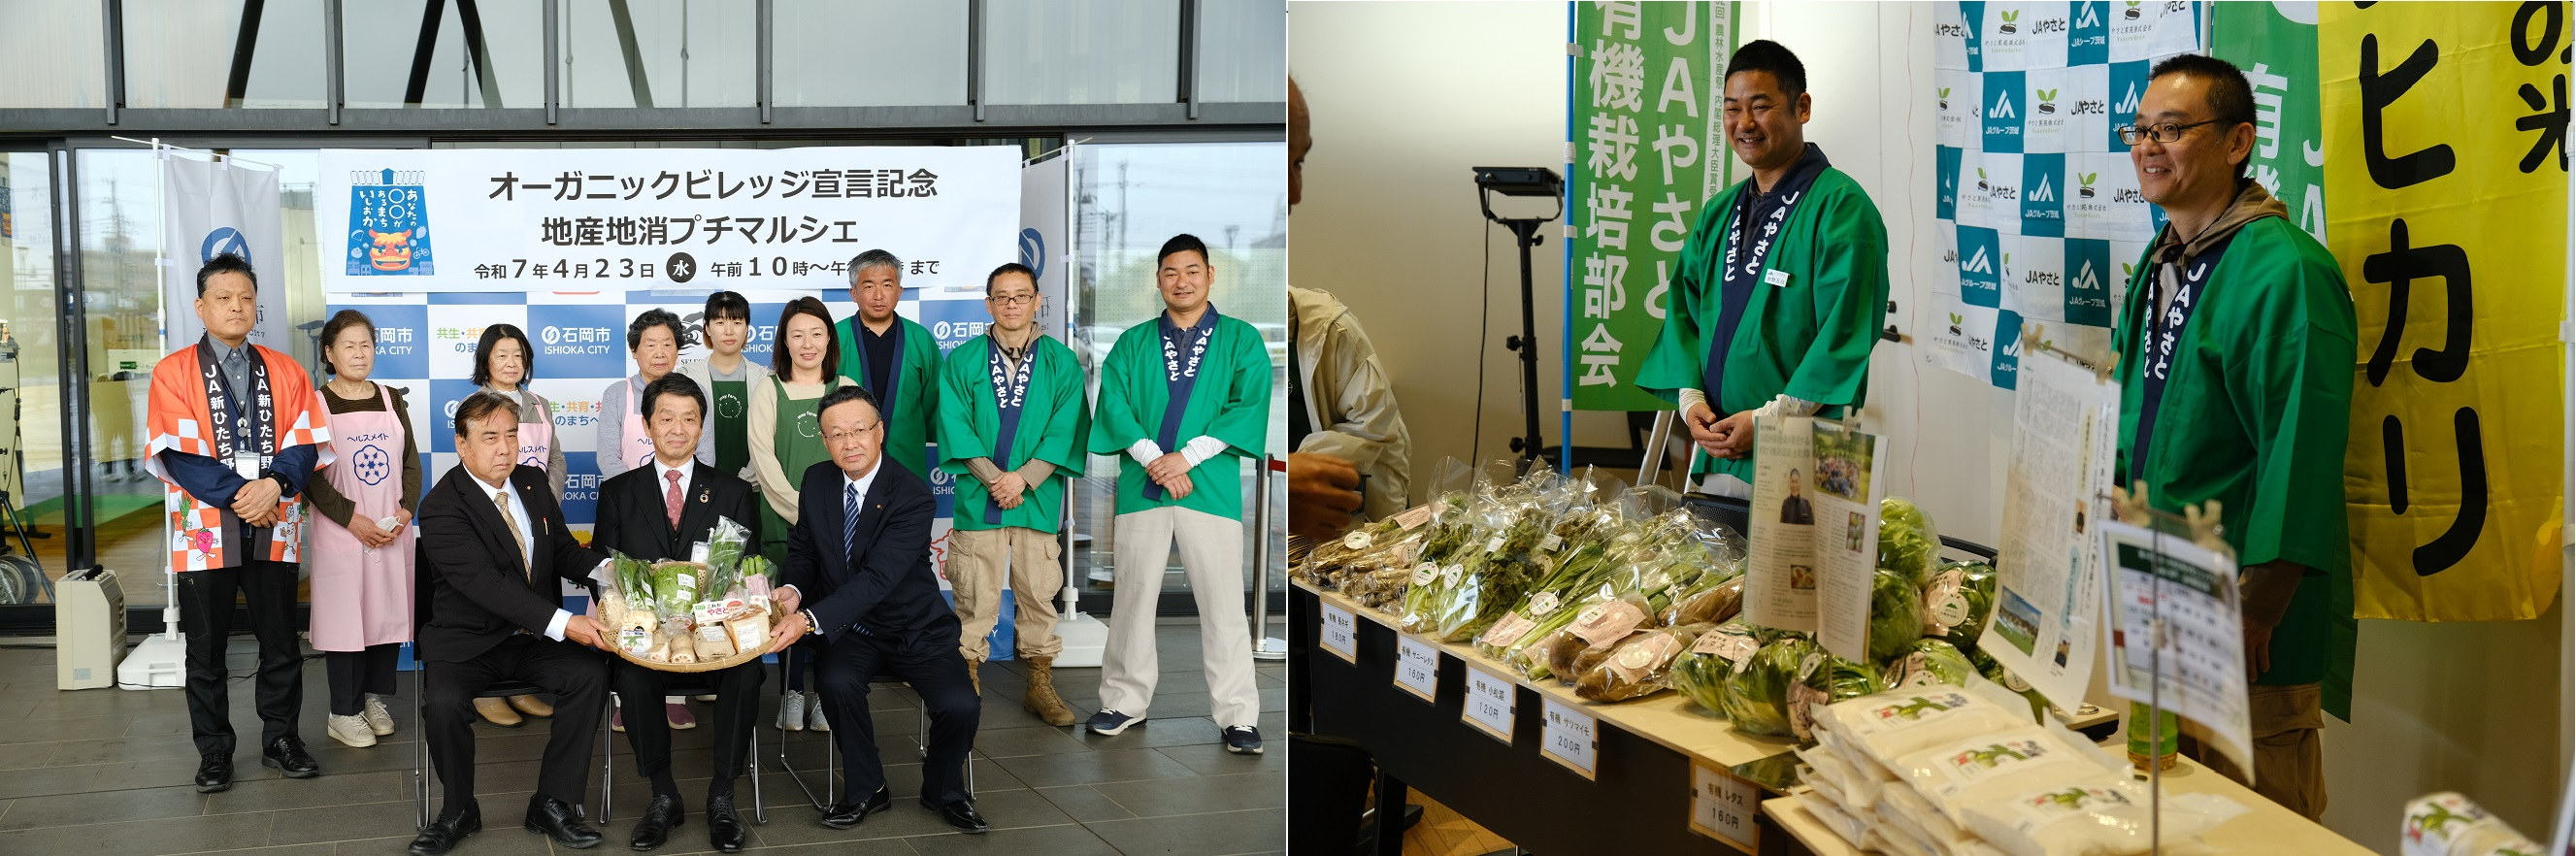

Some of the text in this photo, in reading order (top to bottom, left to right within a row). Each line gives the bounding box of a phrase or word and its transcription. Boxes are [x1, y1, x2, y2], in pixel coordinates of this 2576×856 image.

[2031, 17, 2065, 35] JAやさと
[1715, 24, 1725, 89] 農林水産祭
[2070, 100, 2104, 115] JAやさと
[489, 169, 939, 201] オーガニックビレッジ宣言記念
[359, 190, 379, 227] いしおか
[378, 190, 388, 228] あるまち
[407, 189, 418, 226] あなたの
[541, 214, 859, 247] 地産地消プチマルシェ
[1745, 191, 1800, 276] JAやさと
[710, 255, 852, 278] 午前10時～午
[910, 259, 940, 276] まで
[2025, 270, 2060, 286] JAやさと
[2357, 0, 2489, 577] ヒカリ
[952, 321, 995, 338] 石岡
[2154, 262, 2207, 380] JAやさと
[562, 326, 611, 344] 石岡市
[388, 346, 413, 355] CITY
[454, 343, 477, 353] のま
[545, 345, 611, 355] ISHIOKA CITY
[741, 344, 774, 353] SHIOK
[1183, 327, 1213, 378] JAやさと
[990, 353, 1008, 409] JAやさと
[1010, 353, 1033, 408] JAやさと
[205, 364, 236, 471] JA新ひたち野
[255, 364, 274, 471] JA新ひたち野
[347, 433, 389, 443] ヘルスメイト
[563, 491, 599, 501] IOKA CI
[1328, 612, 1338, 624] 有機
[1331, 631, 1346, 645] 180円
[1402, 645, 1411, 659] 有機
[1408, 667, 1426, 683] 160円
[1475, 679, 1505, 702] 有機 小松菜
[1479, 702, 1499, 720] 120円
[1549, 710, 1590, 737] 有機 サツマイモ
[1558, 735, 1581, 756] 200円
[1707, 782, 1743, 807] 有機 レタス
[1711, 807, 1739, 830] 160円
